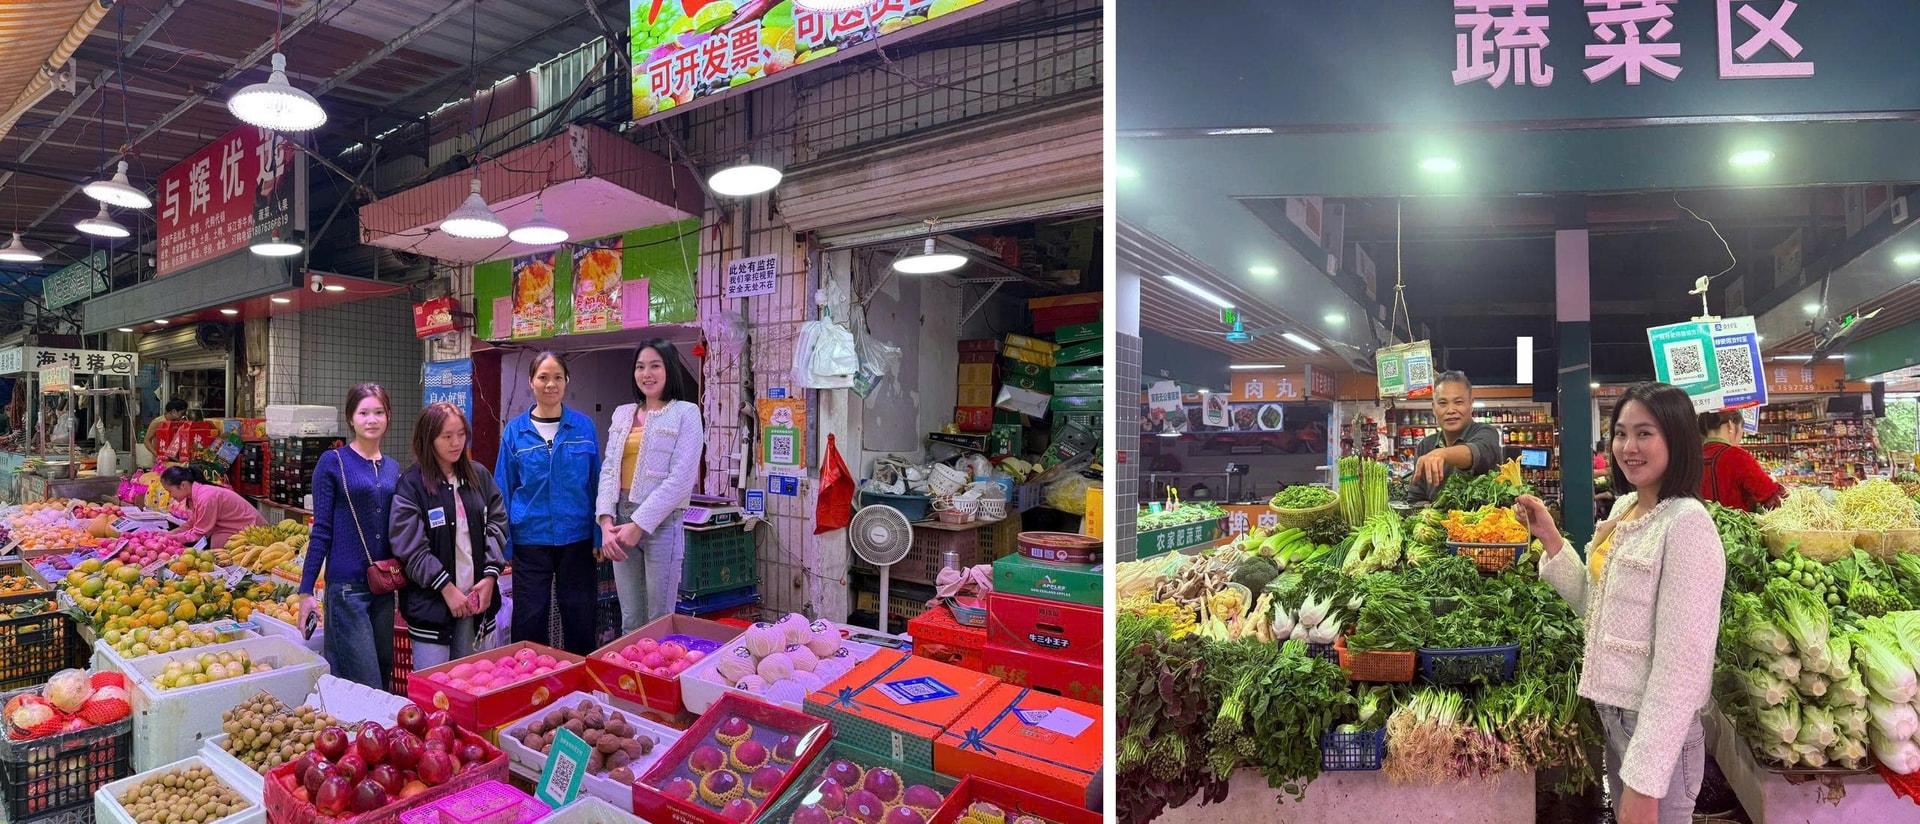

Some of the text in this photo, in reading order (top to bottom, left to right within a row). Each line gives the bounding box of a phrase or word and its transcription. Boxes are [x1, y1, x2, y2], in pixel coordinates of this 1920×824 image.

[1451, 0, 1815, 88] 蔬菜区
[729, 257, 776, 276] 此处有监控
[729, 269, 774, 285] 我们掌控视野
[728, 280, 774, 295] 安全无处不在
[36, 350, 106, 371] 海边猪
[1244, 378, 1298, 400] 肉丸
[1156, 525, 1203, 551] 农家肥蔬菜
